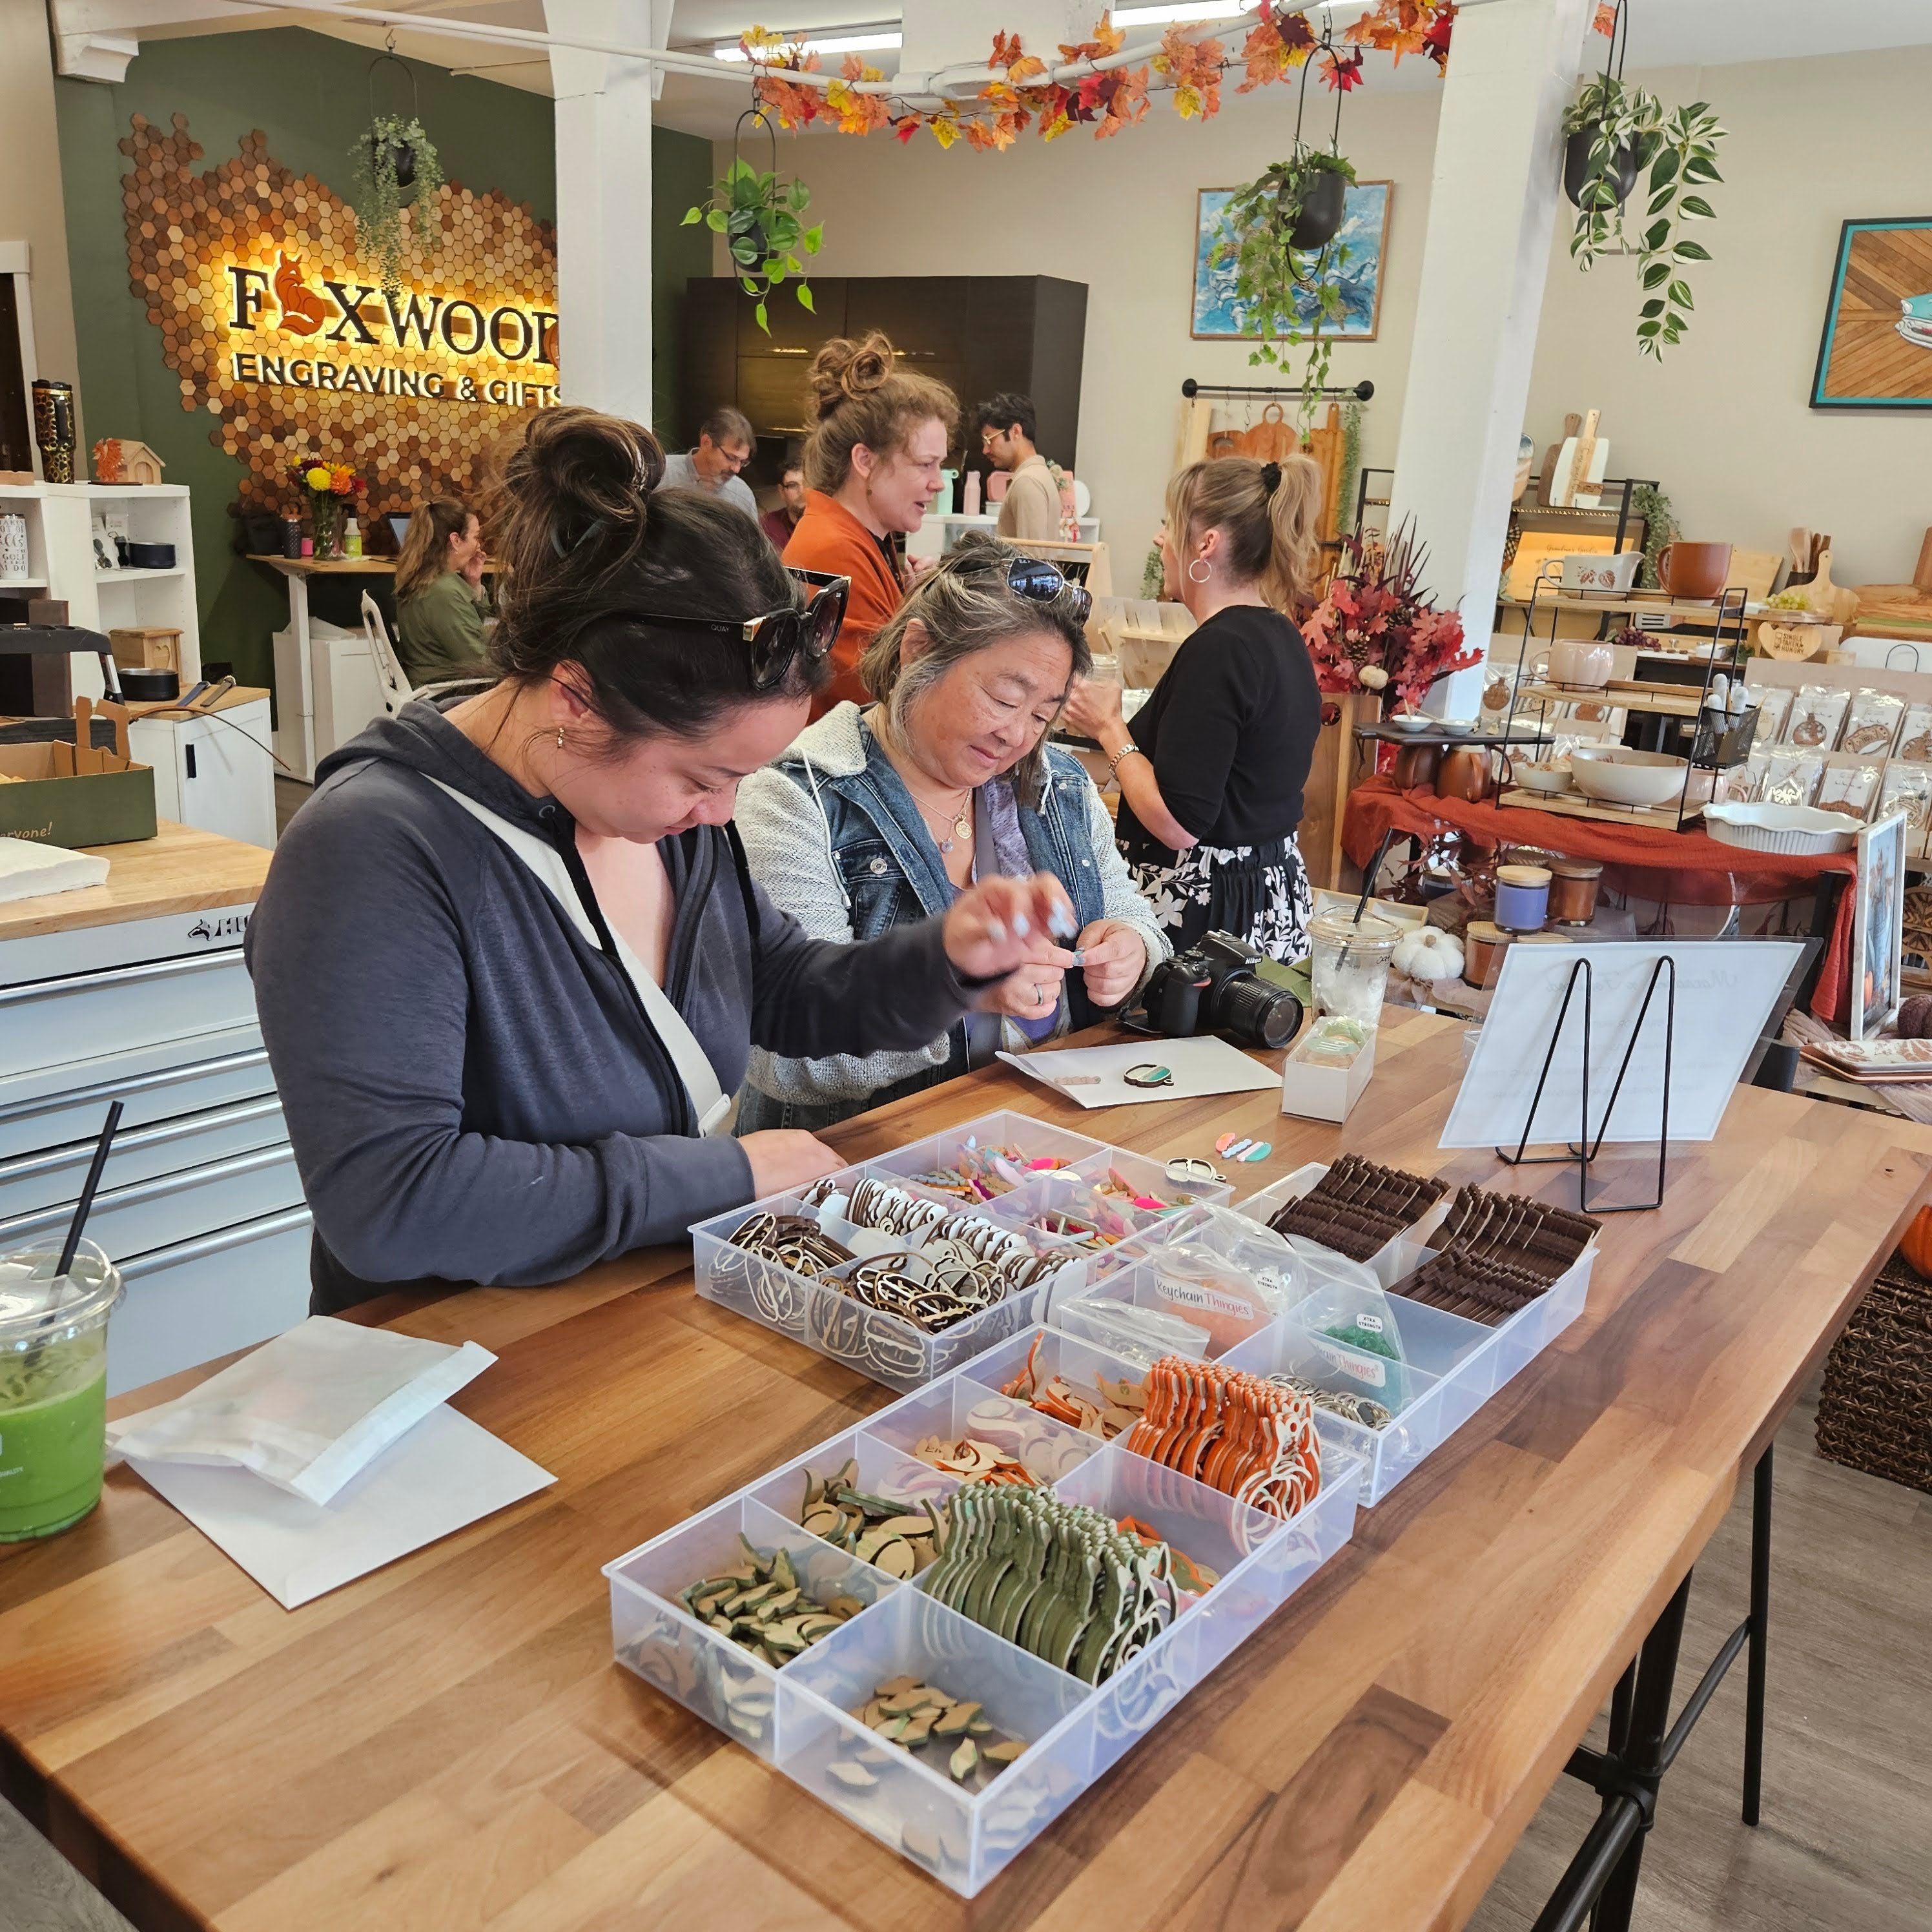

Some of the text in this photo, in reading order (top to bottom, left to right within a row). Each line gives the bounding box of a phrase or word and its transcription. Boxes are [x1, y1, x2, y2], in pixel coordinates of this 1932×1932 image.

[233, 353, 445, 398] ENGRAVING
[459, 376, 478, 401] &
[711, 624, 729, 632] QUAY
[1257, 1280, 1278, 1290] STRENGTH
[1156, 1279, 1249, 1316] Keychain Thingies
